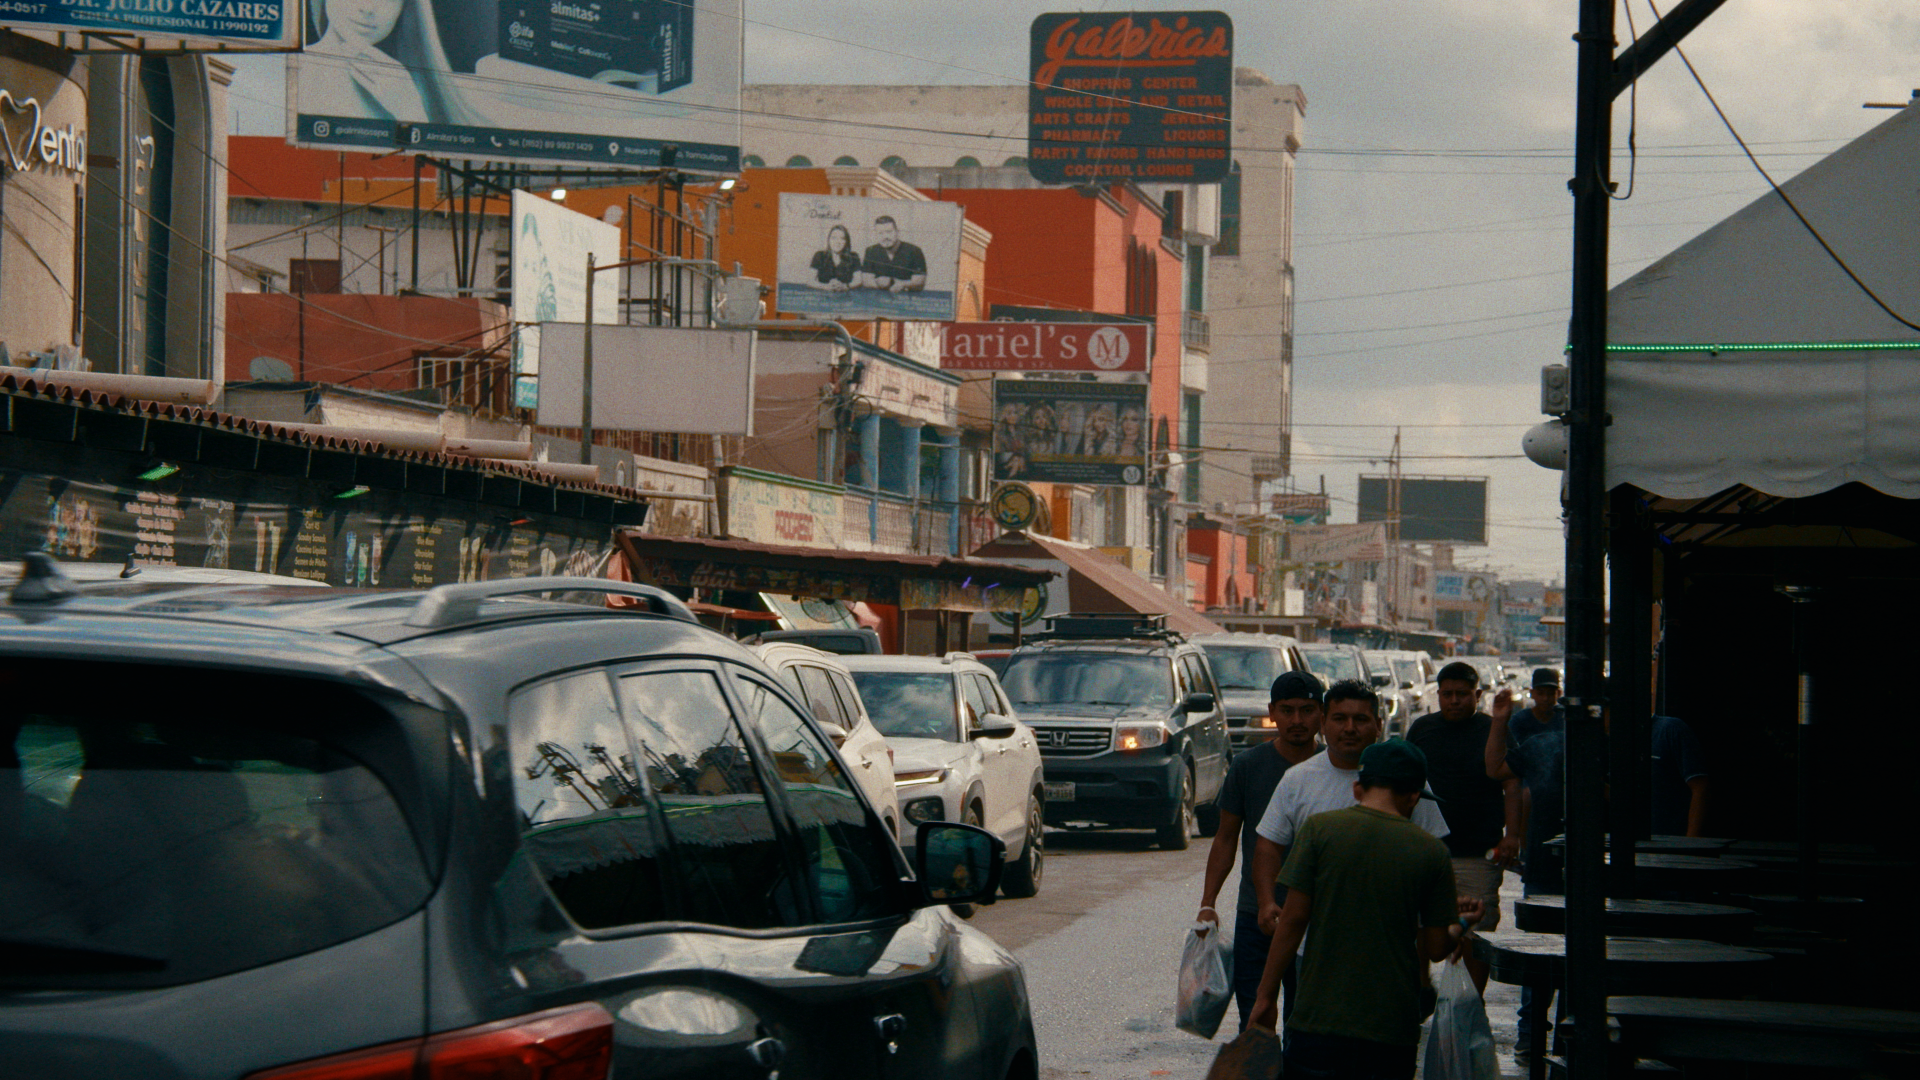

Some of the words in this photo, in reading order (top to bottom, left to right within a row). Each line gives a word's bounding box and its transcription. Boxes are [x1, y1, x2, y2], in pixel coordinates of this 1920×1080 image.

[180, 0, 280, 21] CAZARES
[123, 13, 209, 29] PROFESIONAL
[212, 20, 269, 33] 11990192
[1062, 77, 1132, 90] SHOPPING
[1142, 77, 1198, 90] CENTER
[1045, 96, 1093, 108] WHOLE
[1096, 95, 1131, 108] SALE
[1139, 95, 1168, 107] AND
[1177, 95, 1226, 107] RETAIL
[1033, 113, 1070, 125] ARTS
[1074, 112, 1130, 125] CRAFTS
[1161, 112, 1226, 125] JEWELRY
[1042, 129, 1122, 142] PHARMACY
[1163, 129, 1226, 142] LIQUORS
[1032, 147, 1079, 159] PARTY
[1086, 147, 1139, 159] FAVORS
[1064, 164, 1134, 177] COCKTAIL
[1137, 164, 1194, 176] LOUNGE
[940, 326, 1078, 359] ariel's
